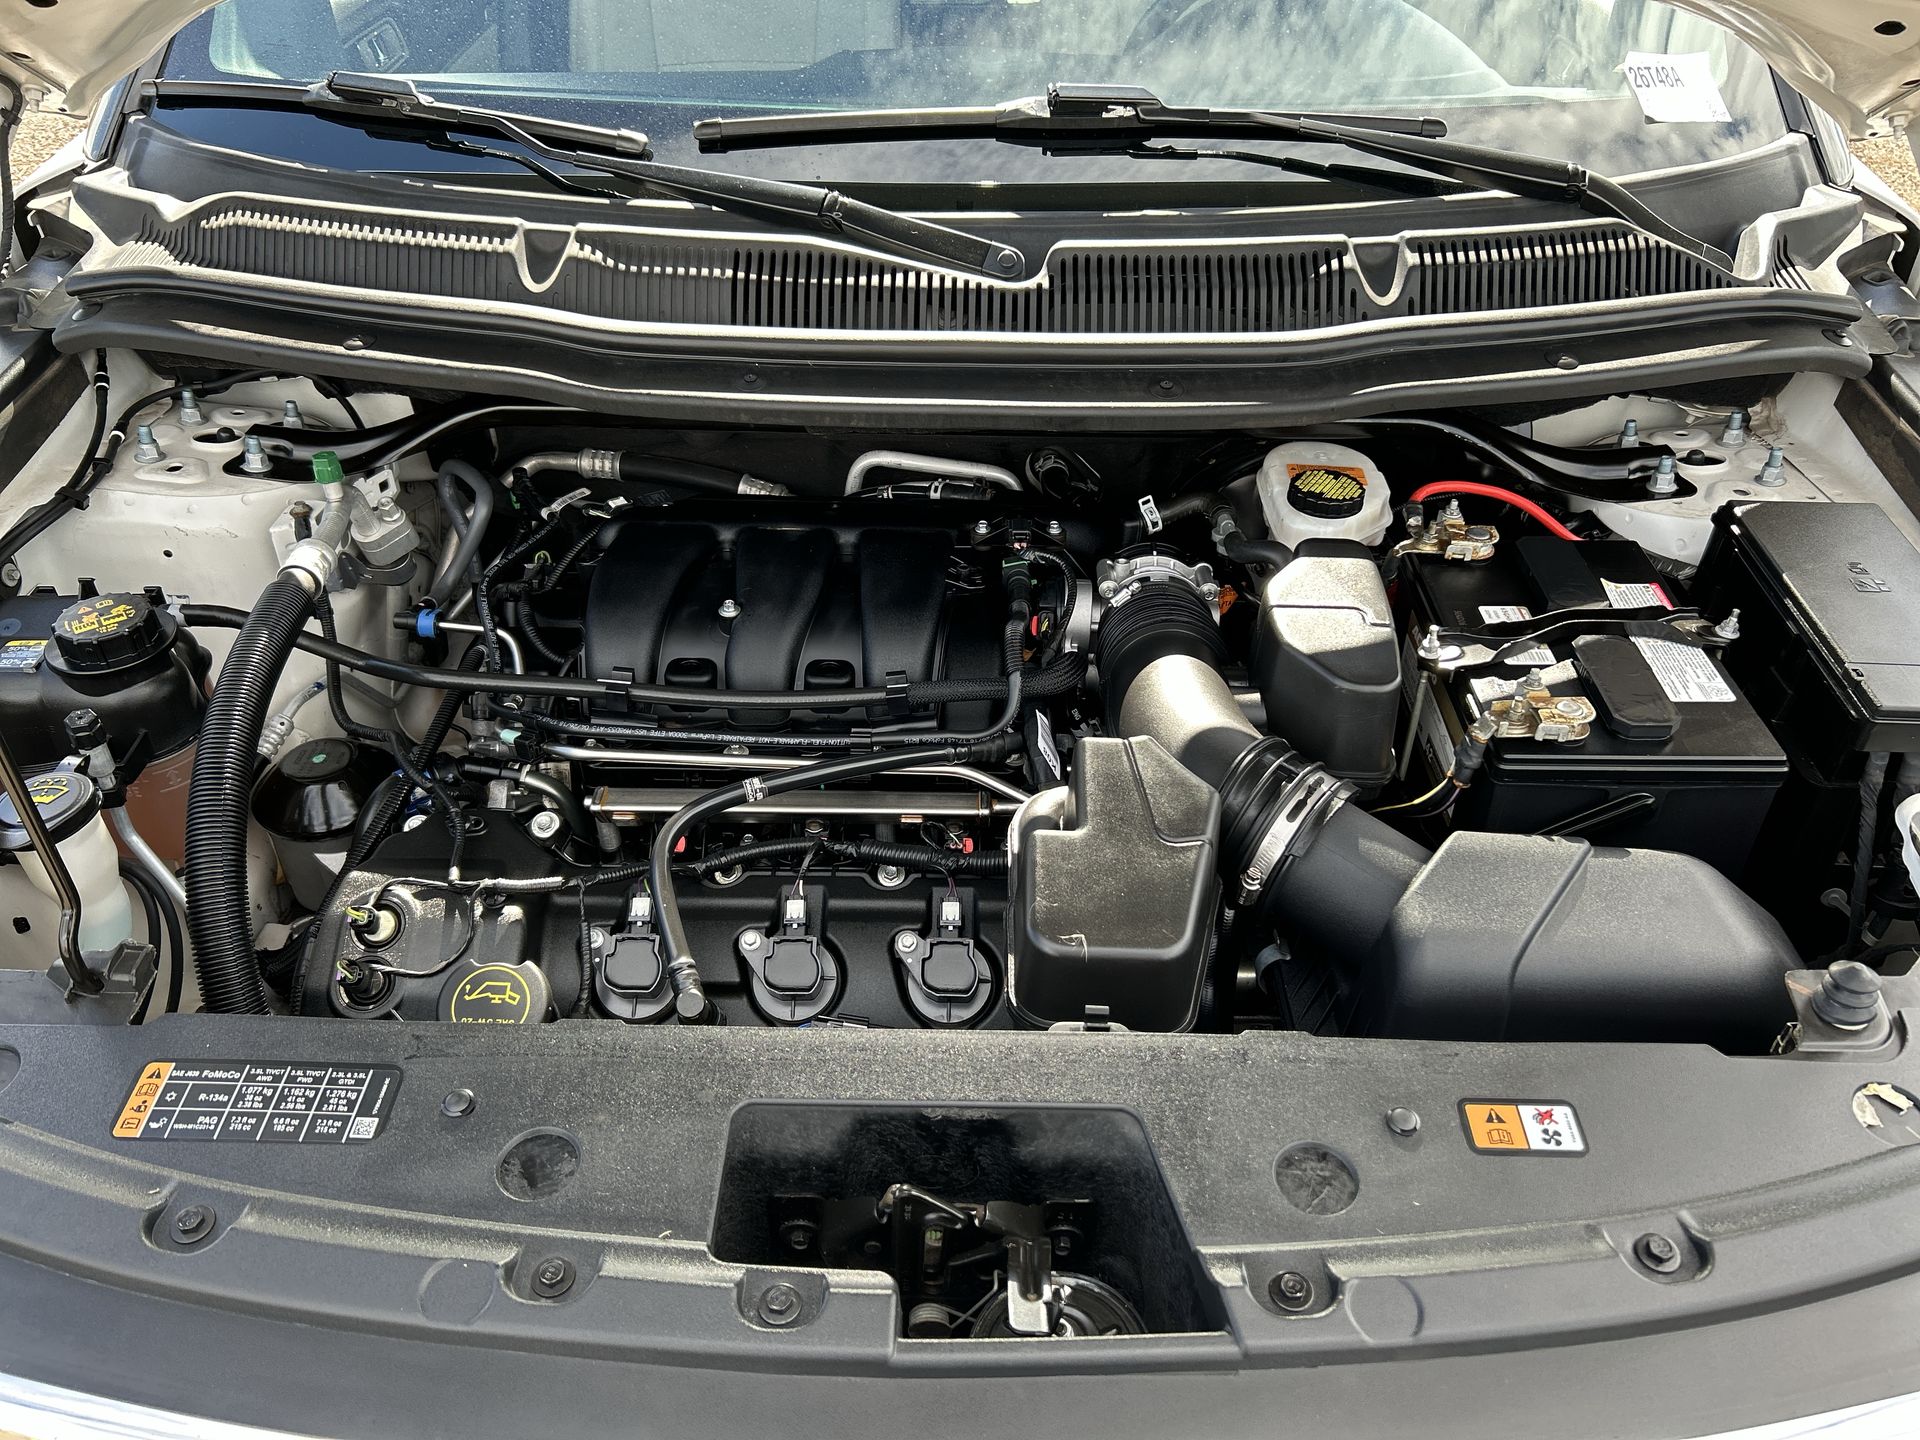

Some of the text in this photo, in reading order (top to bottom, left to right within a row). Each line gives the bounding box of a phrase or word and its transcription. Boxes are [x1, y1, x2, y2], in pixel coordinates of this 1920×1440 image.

[1628, 66, 1685, 88] 26T48A
[201, 1070, 241, 1079] FoMoCo
[241, 1086, 274, 1096] 1.077 kg
[283, 1088, 316, 1098] 1.162 kg
[346, 1091, 358, 1100] kg
[198, 1093, 229, 1102] R-134a
[197, 1116, 219, 1124] PAG
